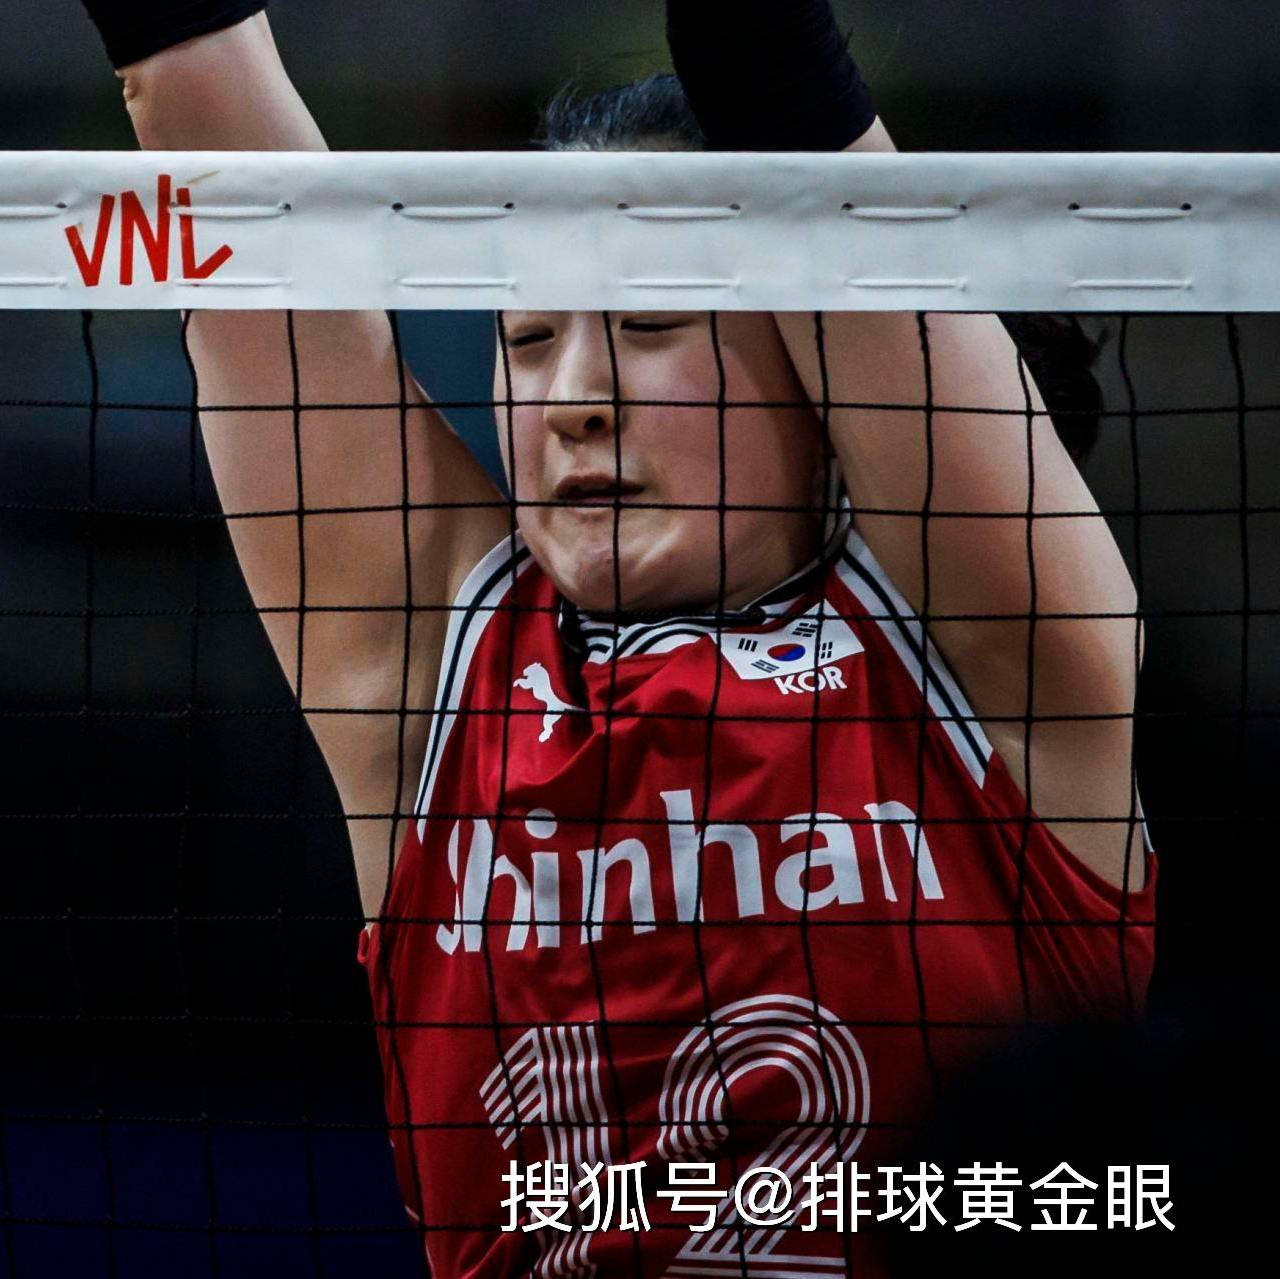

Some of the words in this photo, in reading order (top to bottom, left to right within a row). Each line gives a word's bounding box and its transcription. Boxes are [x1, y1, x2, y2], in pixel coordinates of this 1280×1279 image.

[65, 174, 233, 287] VNL
[773, 665, 848, 695] KOR
[478, 992, 871, 1279] 12
